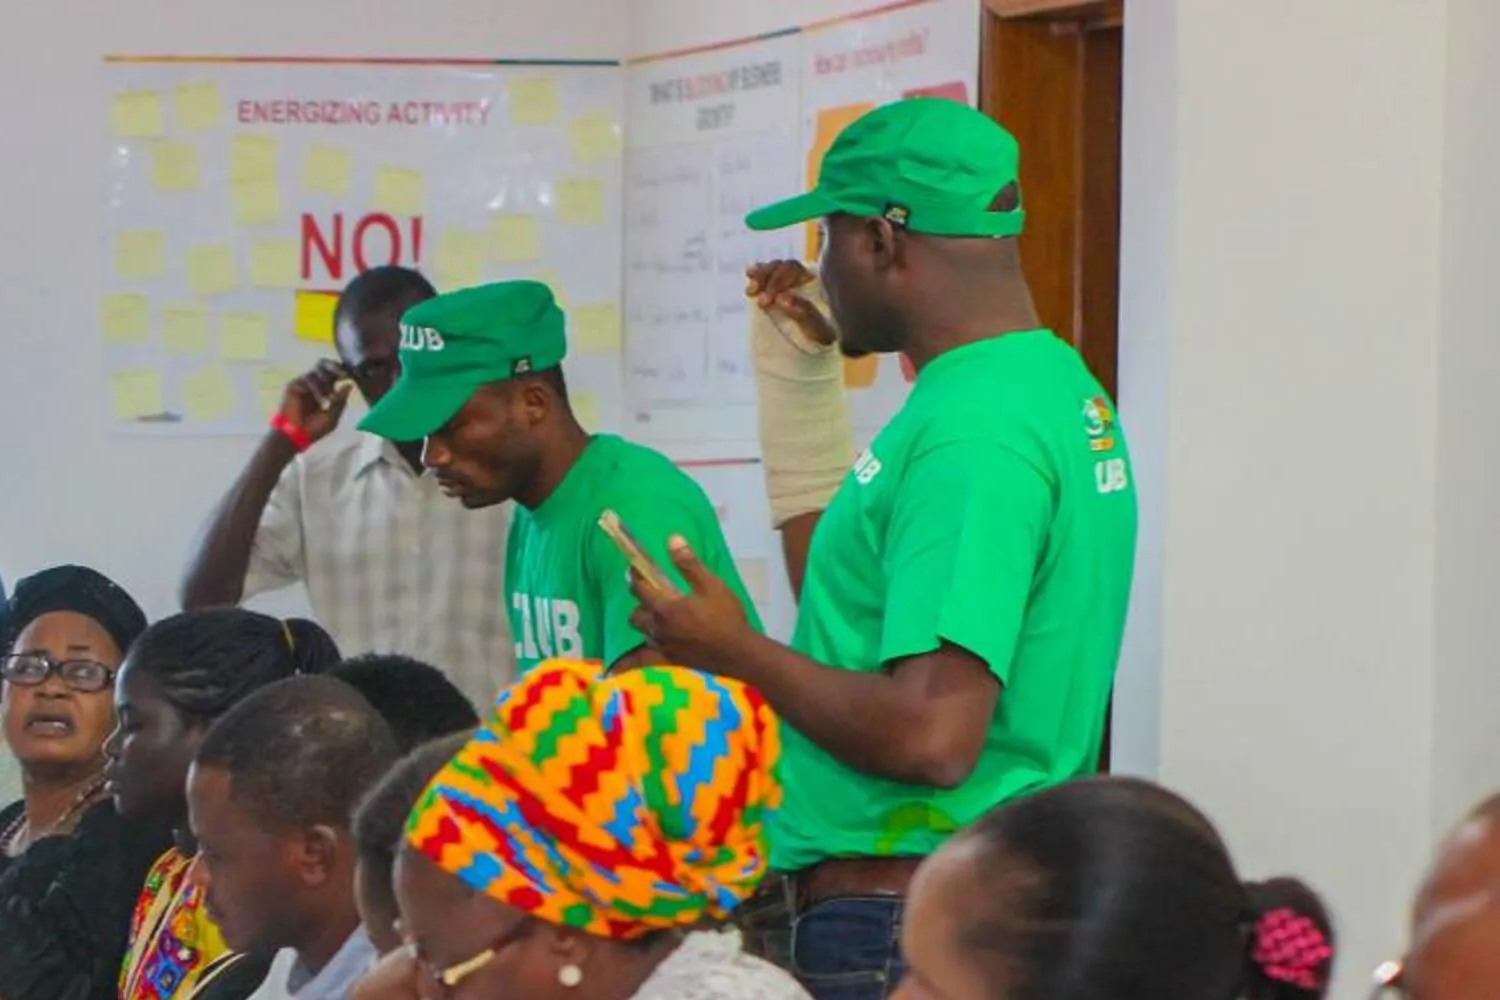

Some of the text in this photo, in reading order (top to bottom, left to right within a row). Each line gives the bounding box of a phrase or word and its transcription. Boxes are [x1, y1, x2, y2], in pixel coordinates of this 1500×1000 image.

[237, 99, 492, 126] ENERGIZING ACTIVITY
[301, 211, 423, 280] NO!
